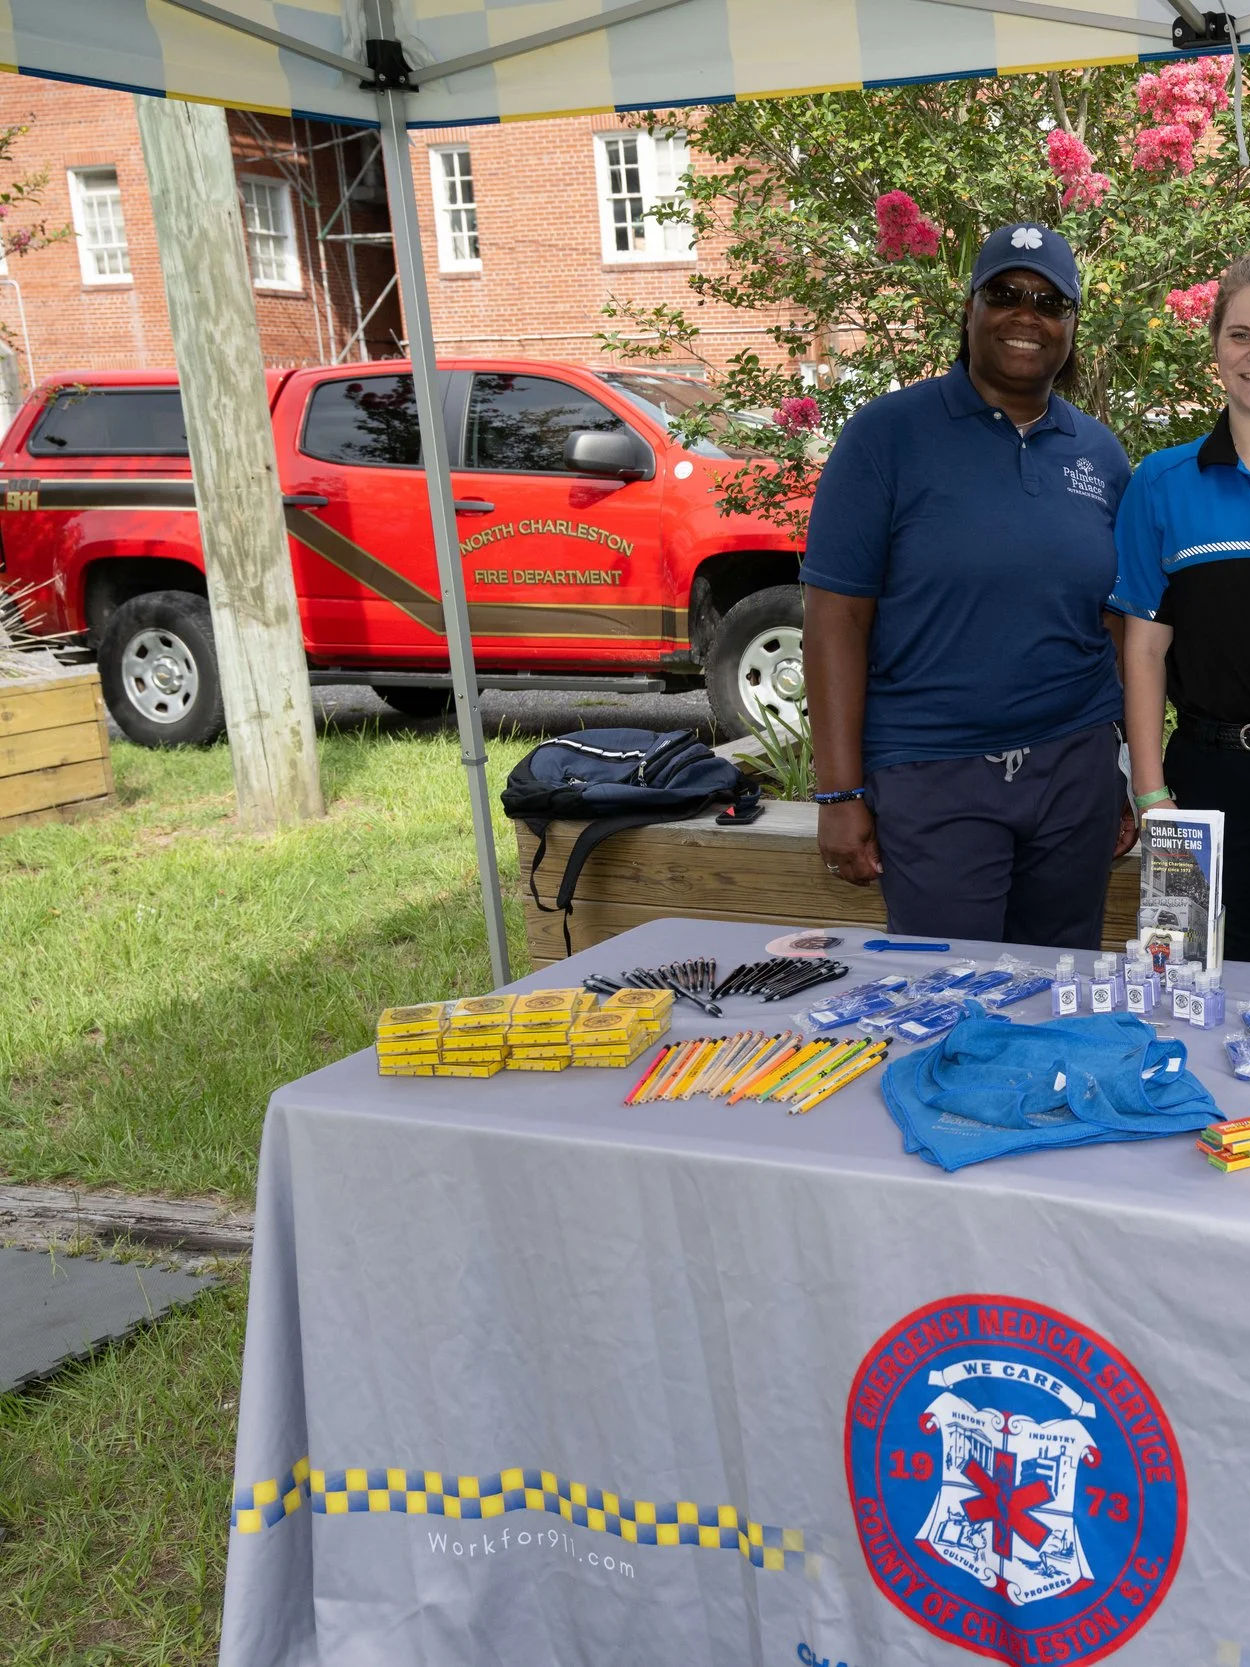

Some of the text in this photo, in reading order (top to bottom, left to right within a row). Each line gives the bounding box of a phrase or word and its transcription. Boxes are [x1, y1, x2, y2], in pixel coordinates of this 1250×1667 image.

[1071, 477, 1103, 496] Palace
[6, 491, 38, 511] 911
[459, 519, 635, 557] NORTH CHARLESTON
[474, 569, 623, 585] FIRE DEPARTMENT
[1151, 826, 1203, 839] CHARLESTON
[1151, 837, 1202, 850] COUNTY EMS
[962, 1362, 1065, 1396] WE CARE
[854, 1307, 1173, 1484] EMERGENCY MEDICAL SERVICE
[951, 1410, 987, 1428] HISTORY
[1028, 1431, 1078, 1445] INDUSTRY
[888, 1449, 1131, 1523] 19 73
[427, 1527, 636, 1579] Workfor911.com
[858, 1497, 929, 1599] COUNTY
[922, 1592, 961, 1626] OF
[1119, 1553, 1166, 1607] S.C.
[942, 1548, 982, 1575] CULTURE
[1023, 1576, 1073, 1600] PROGRESS
